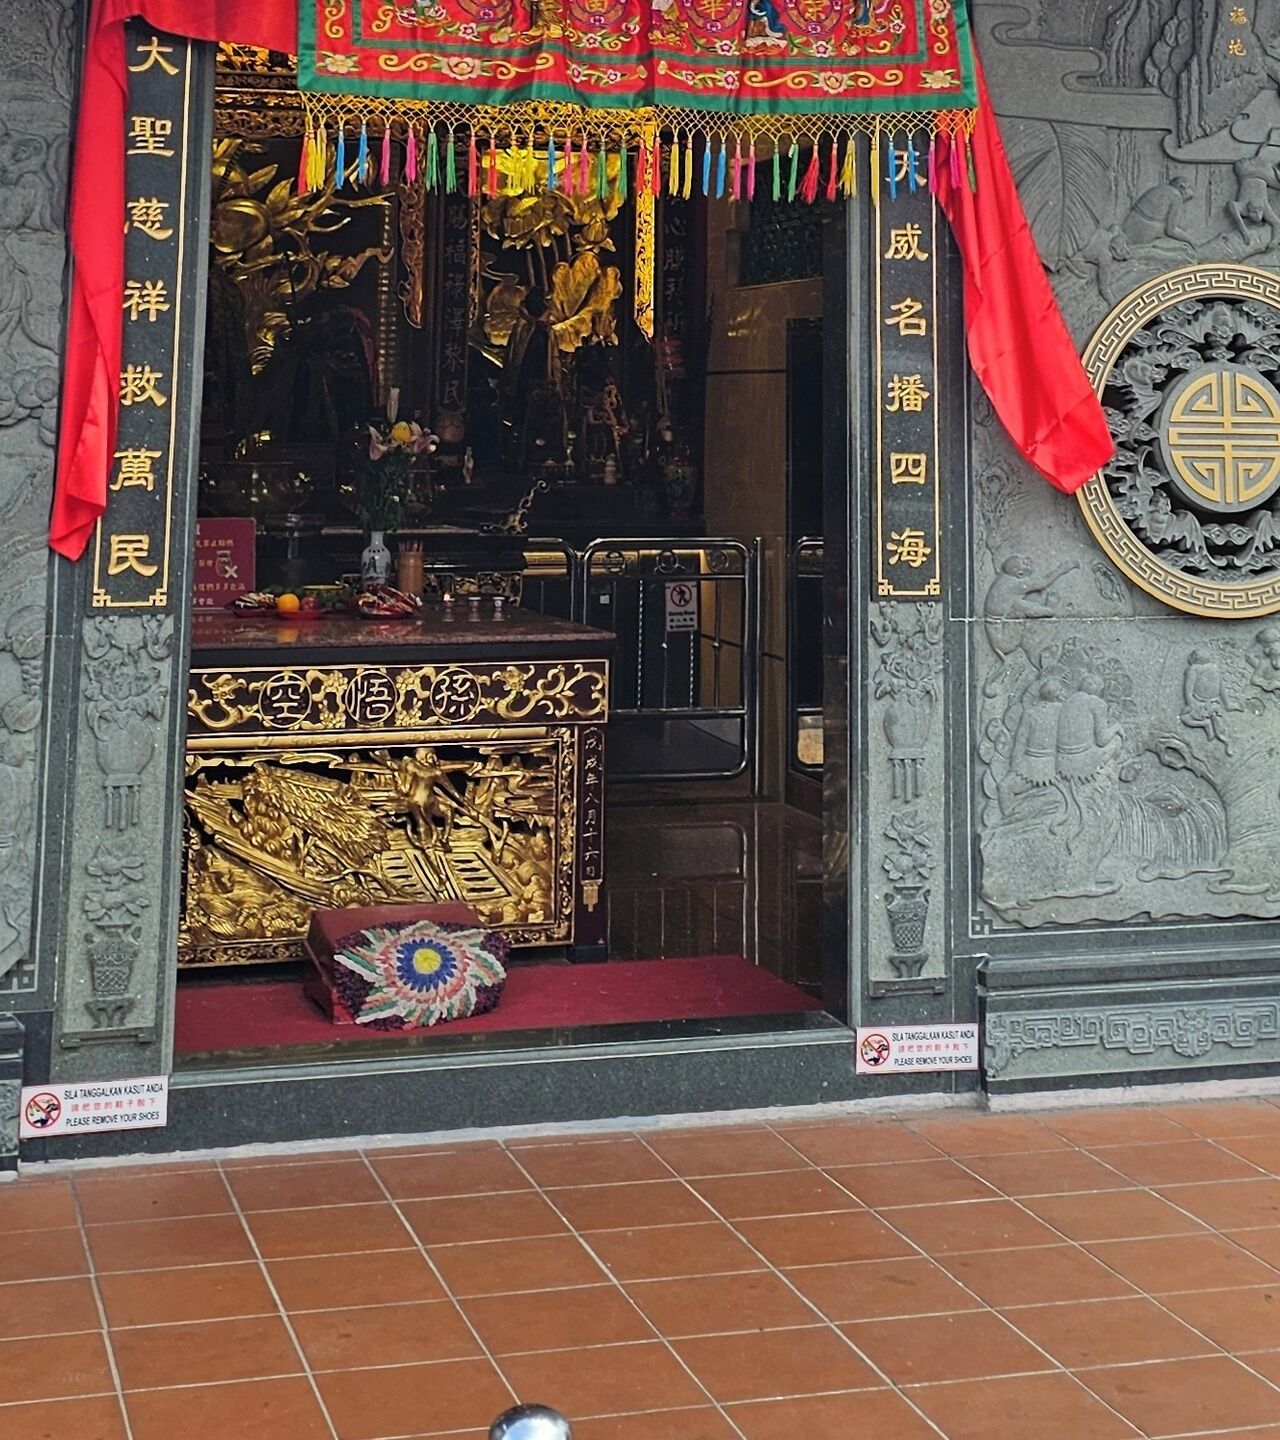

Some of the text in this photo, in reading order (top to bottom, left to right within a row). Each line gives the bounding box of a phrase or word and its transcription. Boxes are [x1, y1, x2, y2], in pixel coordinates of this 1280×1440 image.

[106, 36, 180, 578] 大聖慈祥救萬民
[892, 1030, 975, 1042] SILA TANGGALKAN KASUT ANDA
[894, 1056, 972, 1066] PLEASE REMOVE YOUR SHOES
[64, 1083, 164, 1100] SILA TANGGALKAN KASUT ANDA
[66, 1111, 160, 1127] PLEASE REMOVE YOUR SHOES
